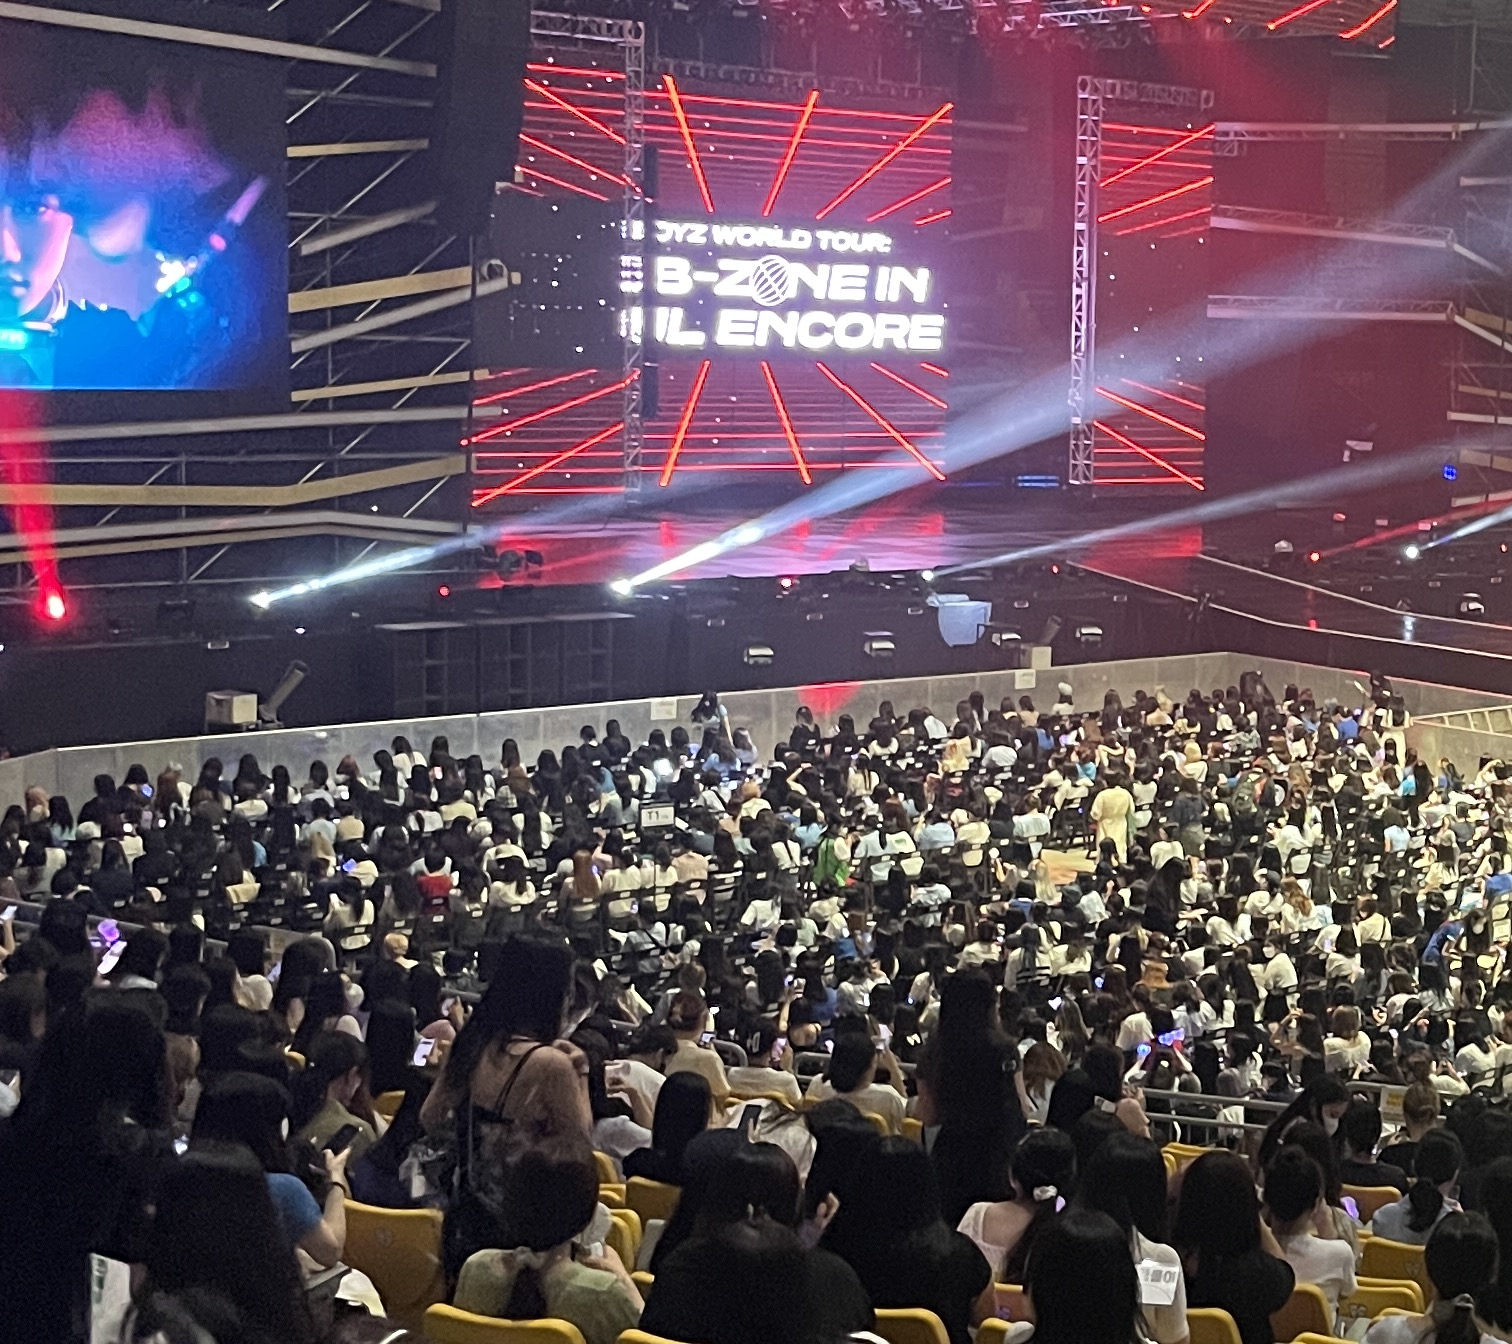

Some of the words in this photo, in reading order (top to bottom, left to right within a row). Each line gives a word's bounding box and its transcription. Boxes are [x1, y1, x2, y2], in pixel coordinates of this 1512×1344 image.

[712, 224, 811, 250] WORLD
[815, 230, 893, 254] TOUR:
[874, 265, 930, 304] IN
[715, 308, 945, 351] ENCORE
